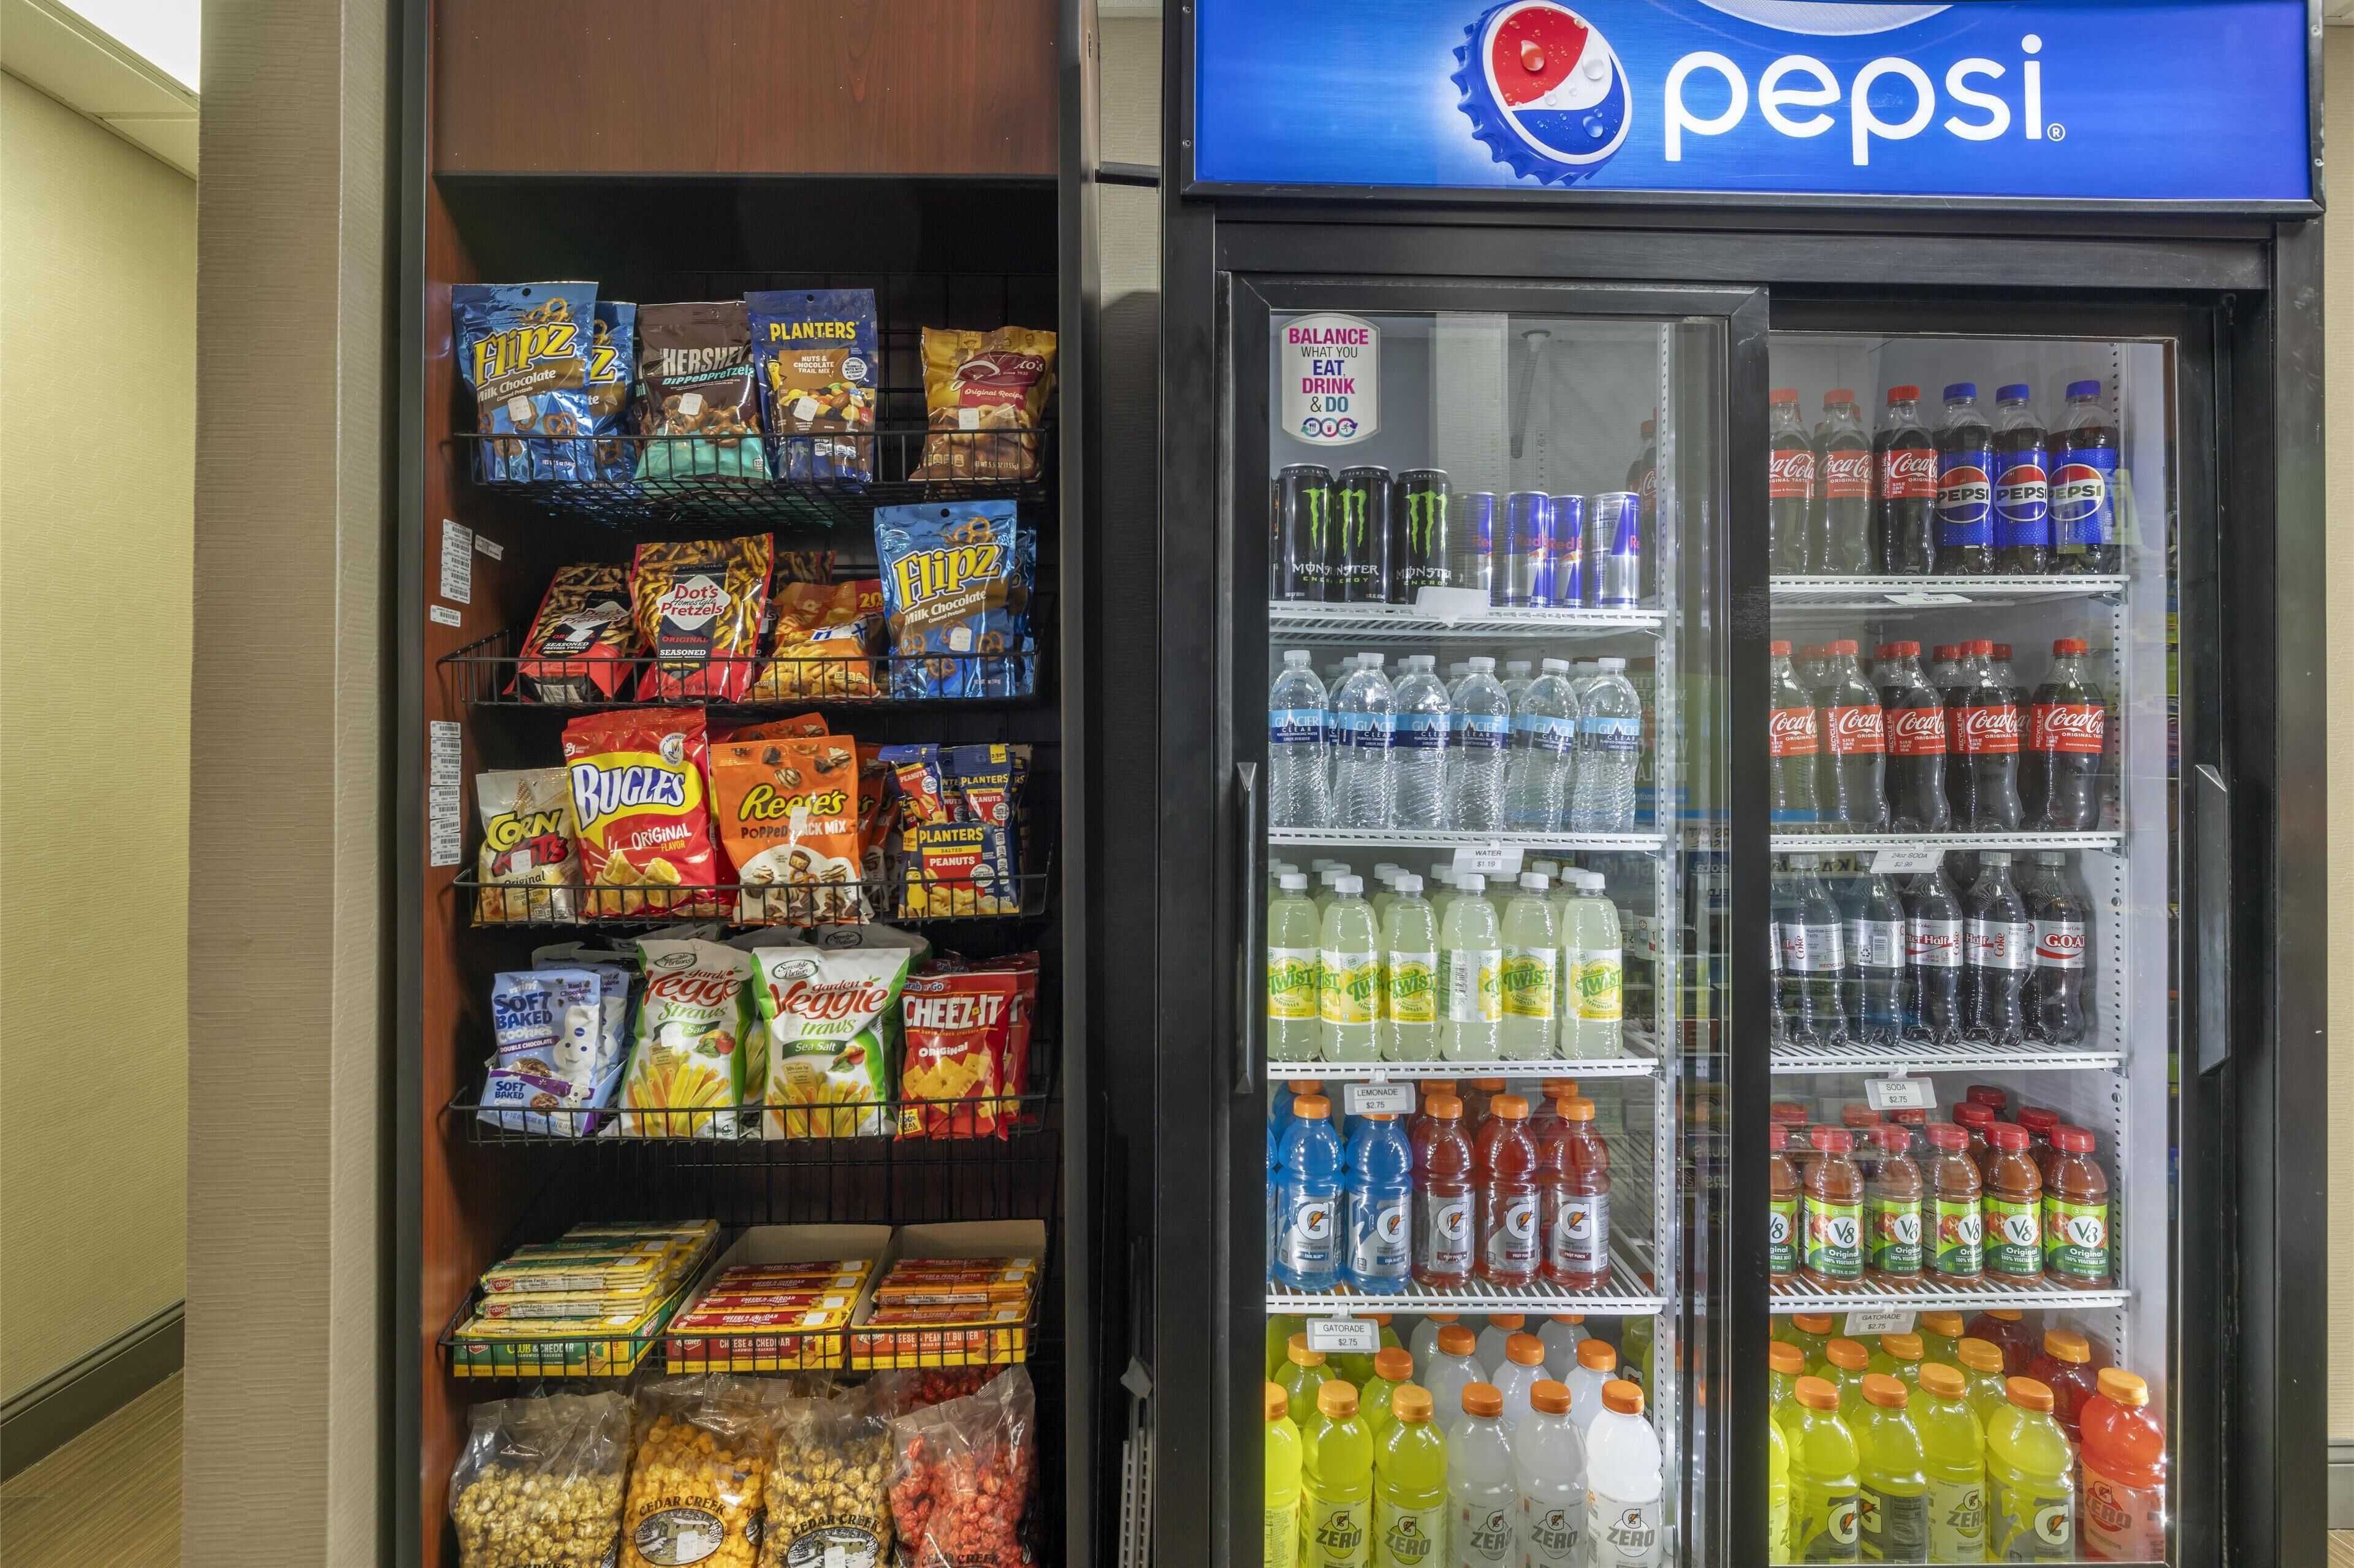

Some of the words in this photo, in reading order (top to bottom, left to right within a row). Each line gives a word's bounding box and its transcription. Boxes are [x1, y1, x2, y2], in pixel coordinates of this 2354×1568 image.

[1664, 33, 2042, 166] pepsi
[770, 321, 856, 342] PLANTERS
[1289, 328, 1368, 344] BALANCE
[473, 322, 578, 390] Flipz
[1301, 346, 1333, 357] WHAT
[1336, 347, 1358, 358] YOU
[1313, 360, 1346, 378] EAT,
[500, 369, 556, 394] Chocolate
[1302, 378, 1355, 394] DRINK
[497, 391, 513, 402] Covered
[999, 390, 1024, 400] Recipe
[1310, 396, 1322, 413] &
[1325, 396, 1349, 413] DO
[1937, 489, 1989, 503] PEPSI
[1997, 487, 2046, 501] PEPSI
[2049, 485, 2101, 498] PEPSI
[892, 543, 1002, 612] Flipz
[674, 584, 718, 599] Dot's
[660, 603, 723, 616] Pretzels
[670, 598, 717, 607] Homestyle
[905, 608, 929, 625] Milk
[931, 590, 986, 615] Chocolate
[928, 615, 947, 624] Covered
[947, 607, 966, 619] Pretzels
[1829, 712, 1834, 721] ME
[1957, 712, 1962, 721] ME
[2036, 708, 2042, 718] ME
[1275, 716, 1318, 728] GLACIER
[1542, 734, 1569, 742] CLEAR
[899, 769, 928, 783] PEANUTS
[961, 774, 1008, 785] PLANTERS
[571, 764, 685, 831] BUGLES
[487, 808, 563, 853] CORN
[920, 827, 984, 844] PLANTERS
[661, 840, 685, 852] FLAVOR
[930, 856, 975, 866] PEANUTS
[1796, 935, 1805, 959] Coke
[1924, 935, 1949, 946] Half
[1966, 934, 1989, 945] Half
[1994, 933, 2005, 957] Coke
[560, 988, 591, 996] Chocolate
[810, 980, 859, 993] garden
[493, 991, 553, 1015] SOFT
[769, 980, 889, 1021] Veggie
[658, 1002, 728, 1020] Straws
[496, 1011, 553, 1029] BAKED
[500, 1043, 521, 1052] DOUBLE
[522, 1038, 553, 1048] CHOCOLATE
[795, 1041, 815, 1052] Sea
[817, 1042, 836, 1052] Salt
[496, 1081, 526, 1091] SOFT
[1357, 1088, 1398, 1097] LEMONADE
[1366, 1101, 1385, 1109] $2.75
[1834, 1221, 1855, 1244] V8
[1900, 1220, 1919, 1242] V8
[2010, 1220, 2033, 1241] V8
[2074, 1221, 2098, 1243] V8
[1829, 1249, 1859, 1258] Original
[2006, 1247, 2037, 1256] Original
[2070, 1248, 2103, 1258] Original
[487, 1279, 511, 1289] Keebler
[485, 1304, 507, 1314] Keebler
[638, 1495, 681, 1517] CEDAR
[685, 1495, 727, 1517] CREEK
[791, 1514, 835, 1535] CEDAR
[839, 1514, 880, 1532] CREEK
[1946, 1510, 1986, 1528] ZERO
[1316, 1528, 1362, 1549] ZERO
[1384, 1530, 1432, 1556] ZERO
[1471, 1527, 1513, 1550] ZERO
[1532, 1525, 1578, 1551] ZERO
[1607, 1526, 1655, 1547] ZERO
[957, 1554, 999, 1566] CREEK
